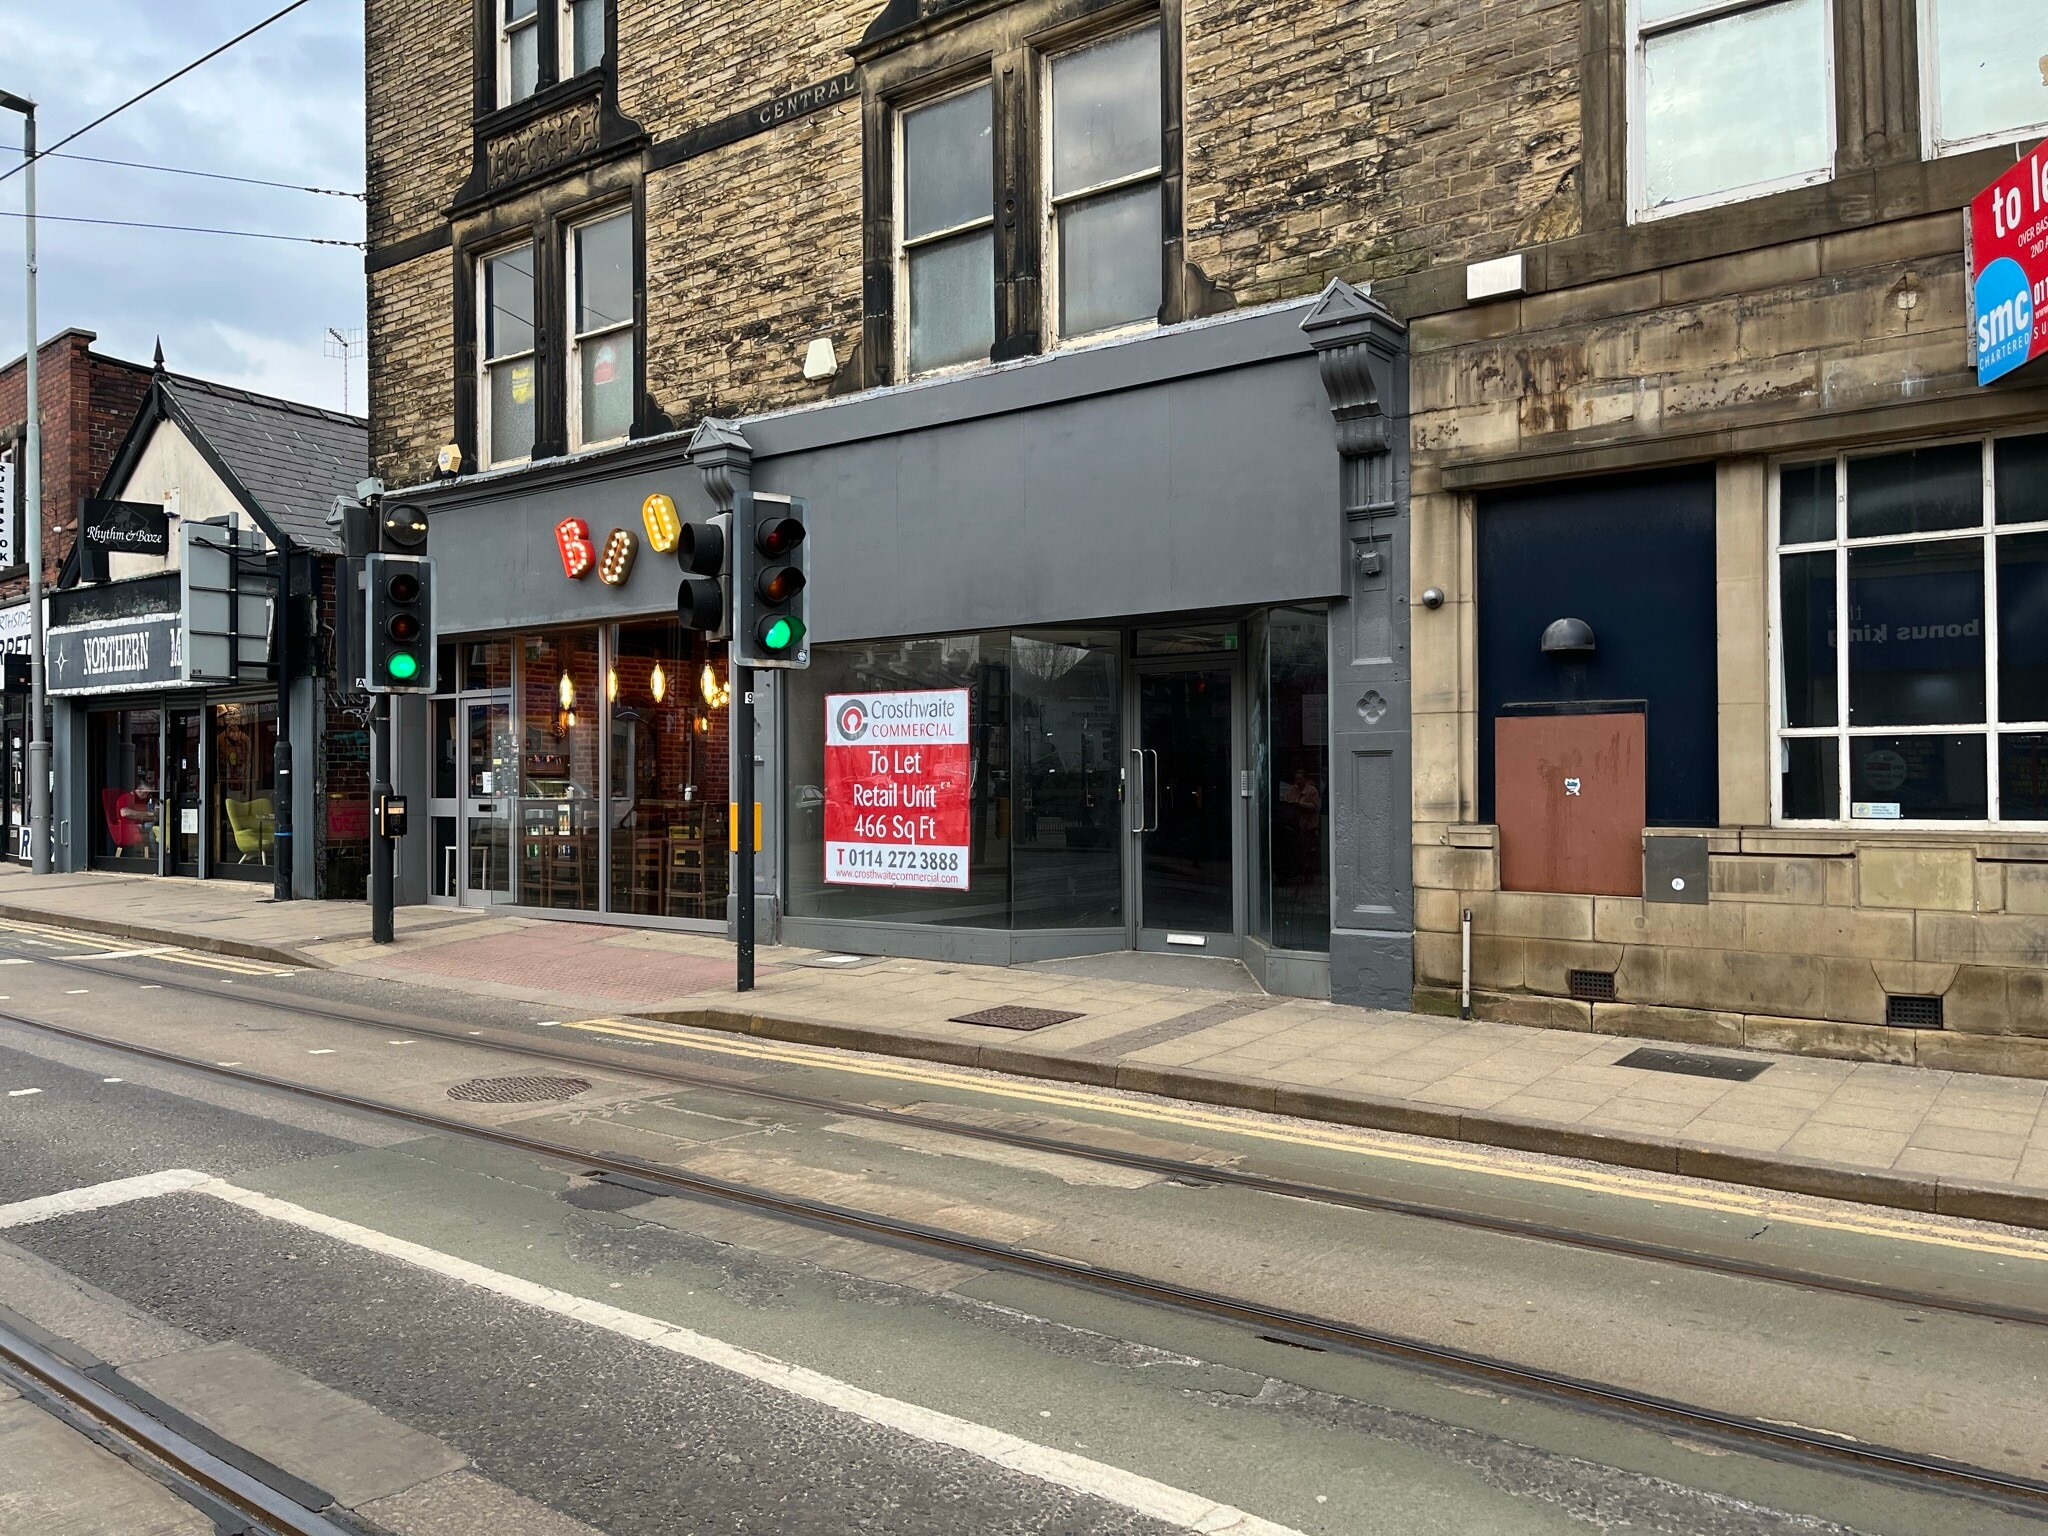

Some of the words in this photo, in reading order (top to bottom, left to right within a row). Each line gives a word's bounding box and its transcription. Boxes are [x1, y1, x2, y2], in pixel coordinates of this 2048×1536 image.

[760, 76, 855, 124] CENTRAL
[1992, 186, 2022, 239] to
[2018, 226, 2035, 248] OVER
[2030, 239, 2044, 259] 2ND
[1978, 290, 2029, 353] smc
[1980, 332, 2029, 372] CHARTERED
[87, 525, 125, 544] Rhythm
[125, 530, 136, 541] &
[83, 631, 150, 675] NORTHERN
[871, 698, 955, 719] Crosthwaite
[872, 723, 955, 738] COMMERCIAL
[868, 750, 889, 774] To
[894, 750, 921, 774] Let
[853, 782, 898, 807] Retail
[903, 784, 937, 808] Unit
[854, 814, 887, 838] 466
[892, 815, 916, 846] Sq
[919, 816, 936, 840] Ft
[837, 848, 845, 865] T
[849, 848, 883, 868] 0114
[888, 850, 917, 869] 272
[920, 852, 959, 871] 3888
[836, 868, 959, 884] www.crosthwaitecommercial.com
